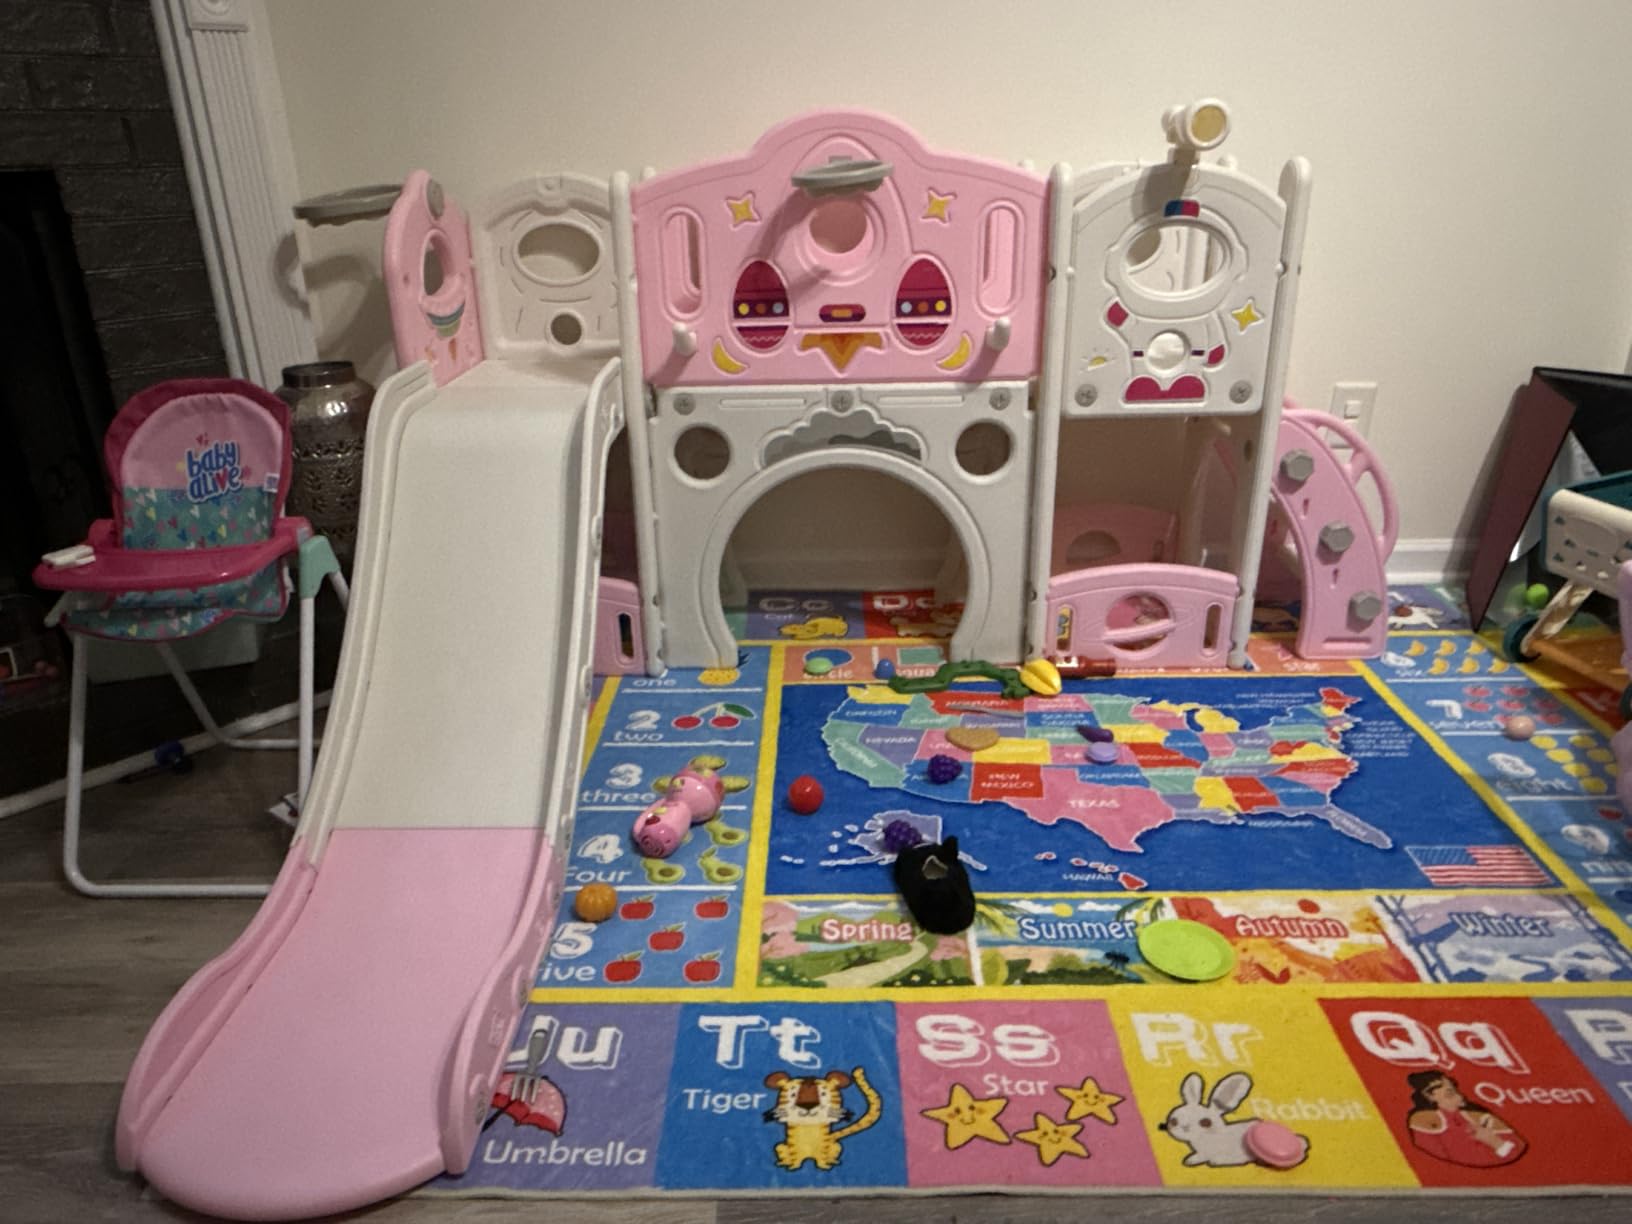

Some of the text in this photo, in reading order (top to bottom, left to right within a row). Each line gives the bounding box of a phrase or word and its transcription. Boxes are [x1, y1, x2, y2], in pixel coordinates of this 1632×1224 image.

[186, 441, 239, 478] baby
[633, 677, 677, 688] one
[625, 709, 661, 732] 2
[613, 732, 664, 743] two
[606, 763, 643, 788] 3
[582, 789, 656, 803] three
[577, 834, 624, 864] 4
[821, 918, 912, 944] Spring
[1019, 917, 1136, 944] Summer
[1234, 915, 1349, 939] Autumn
[1451, 912, 1551, 936] Winter
[549, 921, 598, 960] 5
[538, 962, 596, 982] ive
[698, 1015, 821, 1068] Tt
[914, 1013, 1061, 1068] Ss
[1130, 1012, 1264, 1067] Rr
[1350, 1010, 1531, 1074] Qq
[982, 1073, 1049, 1098] Star
[1474, 1082, 1596, 1106] Queen
[683, 1088, 767, 1115] Tiger
[1251, 1097, 1372, 1121] Rabbit
[483, 1139, 648, 1167] Umbrella
